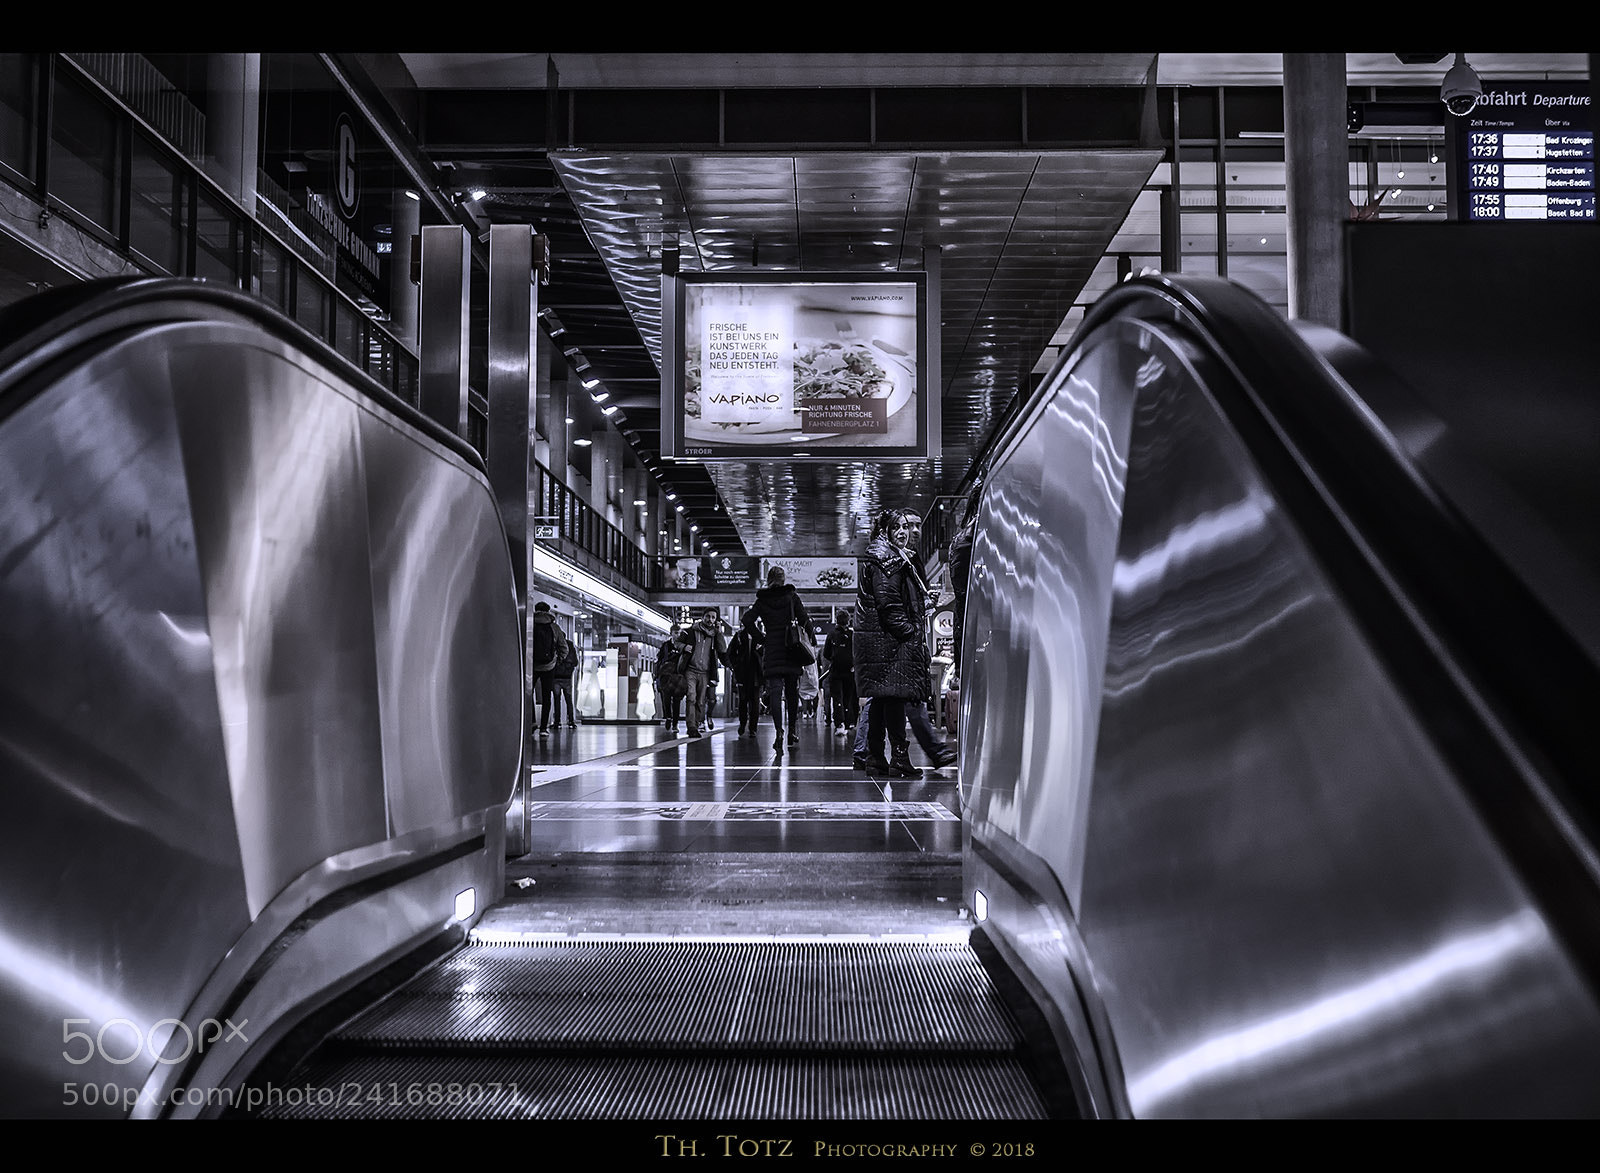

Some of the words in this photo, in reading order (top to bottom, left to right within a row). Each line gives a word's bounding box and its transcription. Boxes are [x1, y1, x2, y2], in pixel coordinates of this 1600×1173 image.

[1533, 94, 1591, 108] Departure
[1545, 119, 1560, 127] Über
[1471, 134, 1498, 145] 17:36
[1546, 136, 1560, 144] Bad
[1471, 146, 1498, 157] 17:37
[1546, 149, 1583, 159] Hugstetten
[339, 124, 355, 207] G
[1472, 164, 1499, 175] 17:40
[1472, 176, 1500, 187] 17:49
[1546, 179, 1591, 187] Baden-Baden
[1472, 194, 1500, 205] 17:55
[1548, 197, 1582, 206] Offenburg
[1473, 206, 1500, 217] 18:00
[1547, 209, 1567, 217] Basel
[1569, 209, 1583, 217] Bad
[709, 323, 748, 332] FRISCHE
[709, 332, 724, 341] IST
[726, 332, 741, 341] BEI
[743, 332, 761, 341] UNS
[764, 332, 779, 341] EIN
[709, 342, 767, 350] KUNSTWERK
[709, 351, 728, 360] DAS
[729, 351, 759, 360] JEDEN
[762, 351, 779, 360] TAG
[709, 361, 729, 370] NEU
[731, 361, 779, 370] ENTSTEHT.
[808, 420, 875, 428] FAHNENBERGPLATZ
